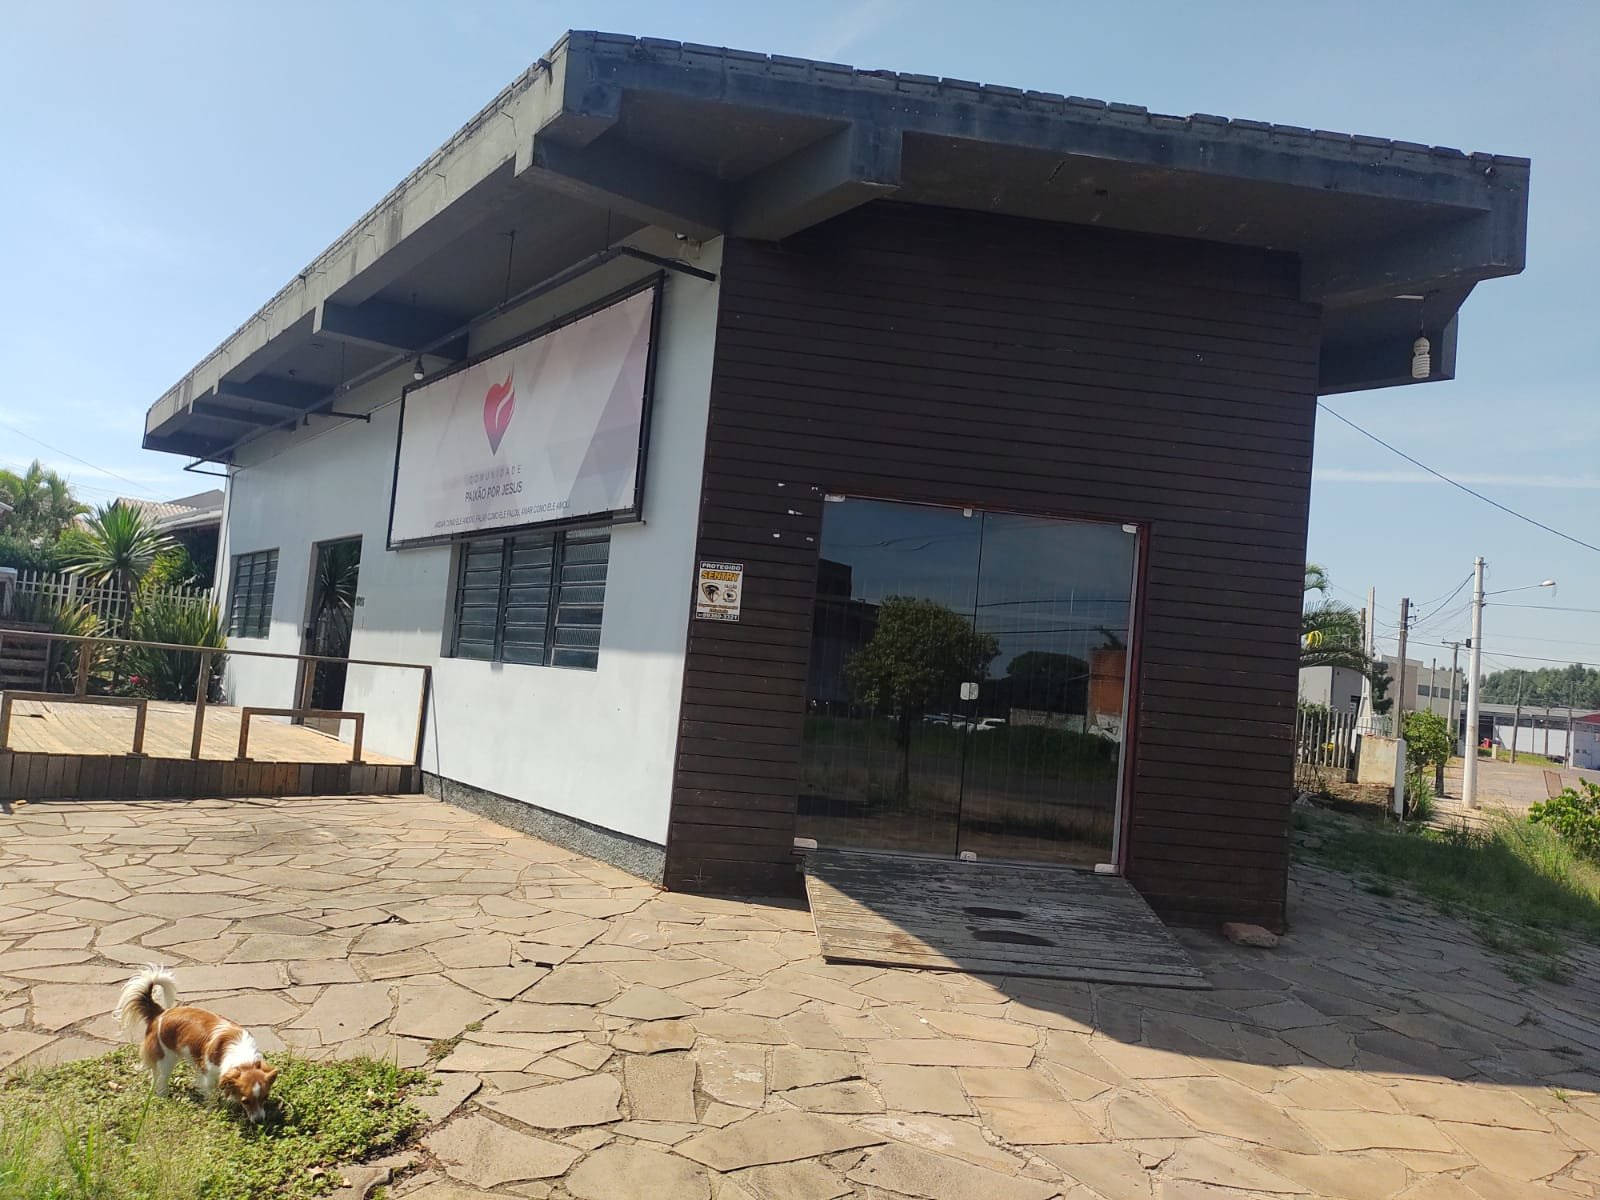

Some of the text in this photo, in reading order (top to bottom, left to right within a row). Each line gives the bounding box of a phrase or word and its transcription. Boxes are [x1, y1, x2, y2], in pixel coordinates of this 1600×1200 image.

[468, 464, 521, 484] COMUNIDADE
[465, 481, 523, 501] PAIXÃO POR JESUS
[702, 563, 741, 571] PROTEGIDO
[701, 571, 740, 582] SENTRY
